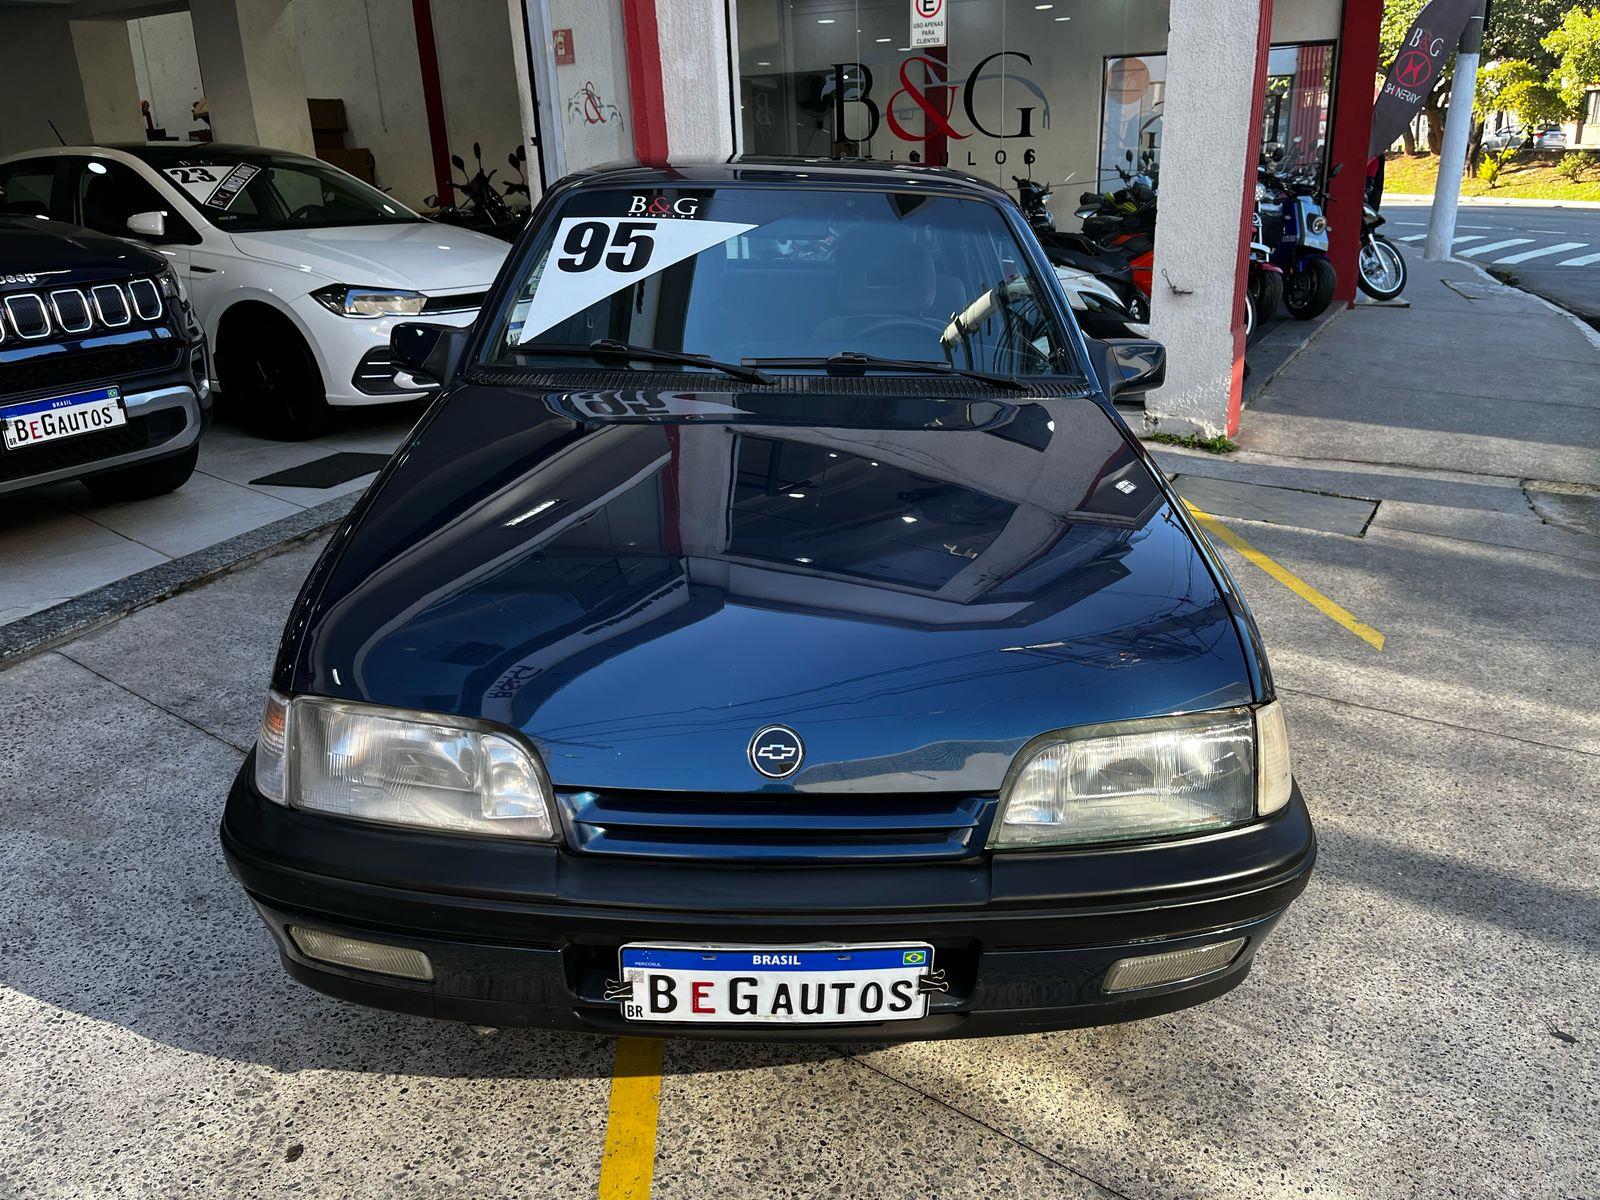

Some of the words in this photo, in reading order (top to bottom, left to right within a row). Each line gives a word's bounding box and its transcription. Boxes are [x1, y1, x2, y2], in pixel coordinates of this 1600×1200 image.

[923, 0, 935, 12] E
[924, 20, 944, 28] APENAS
[831, 51, 1037, 142] B&G
[169, 167, 218, 184] 23
[628, 195, 698, 215] B&G
[557, 221, 658, 273] 95
[52, 399, 72, 409] BRASIL
[752, 954, 802, 966] BRASIL
[627, 1004, 643, 1018] BR
